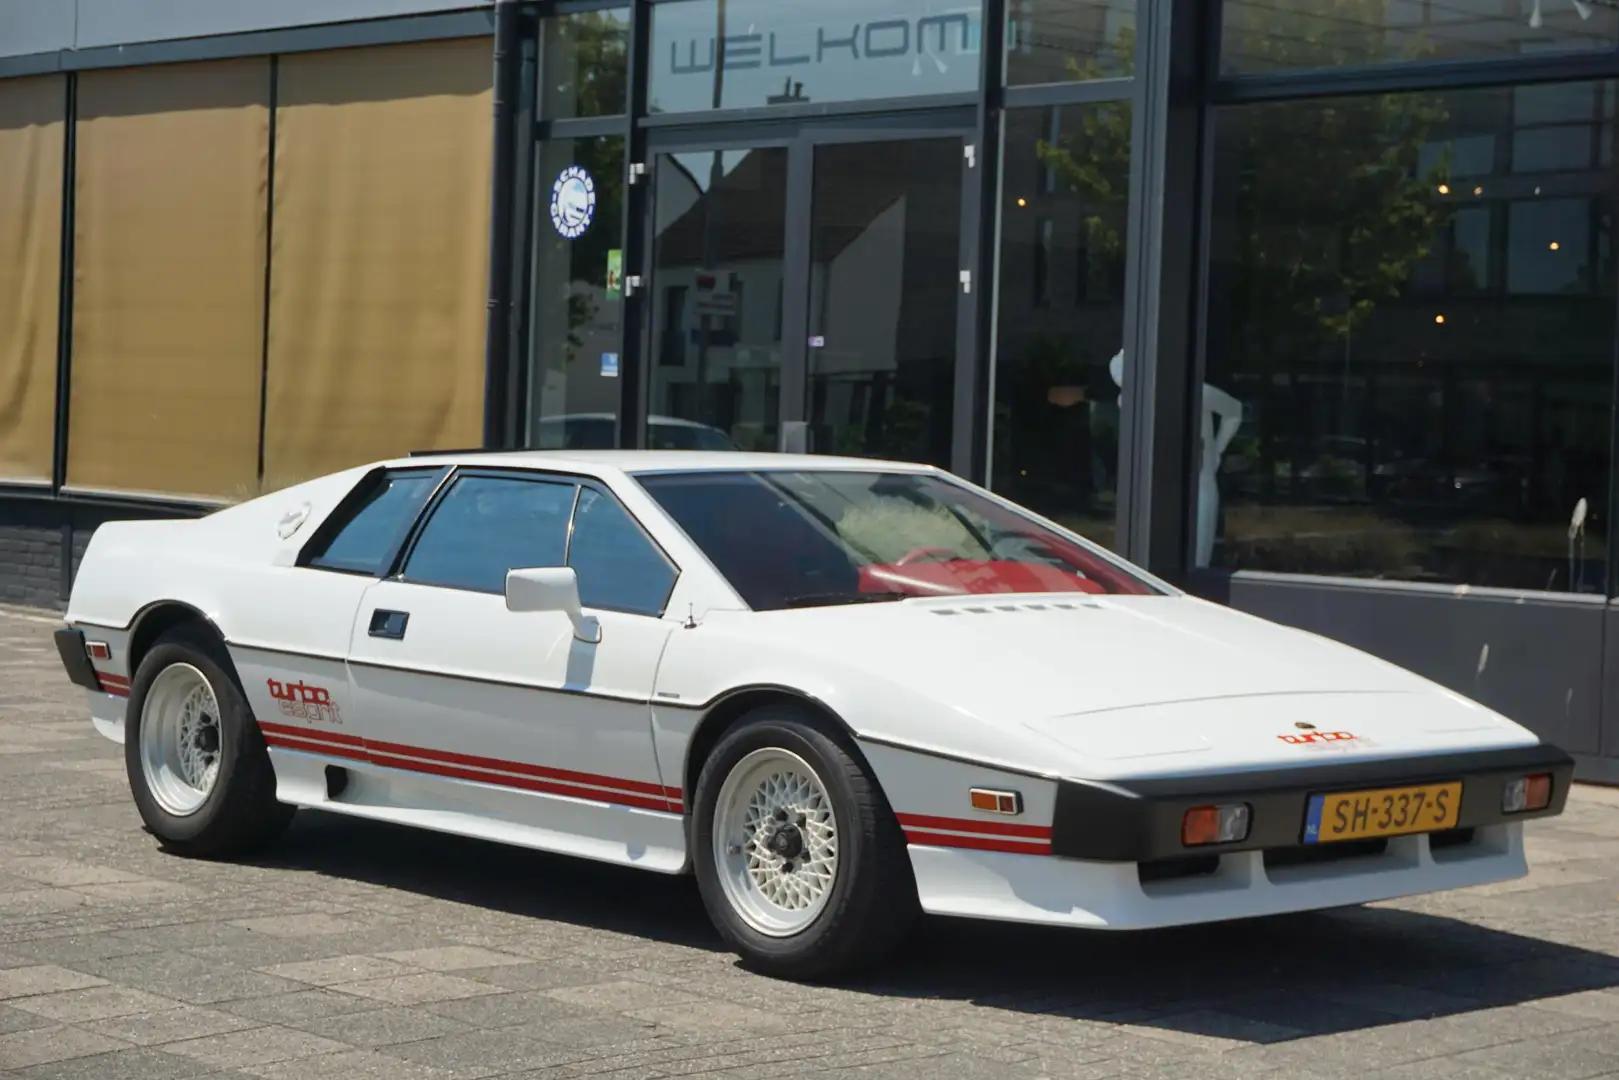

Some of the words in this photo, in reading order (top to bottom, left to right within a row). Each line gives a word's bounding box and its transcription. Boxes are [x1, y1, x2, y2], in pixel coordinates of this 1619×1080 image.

[670, 13, 969, 73] WELKOM
[267, 678, 329, 705] turbo
[1332, 789, 1449, 834] SH-337-S
